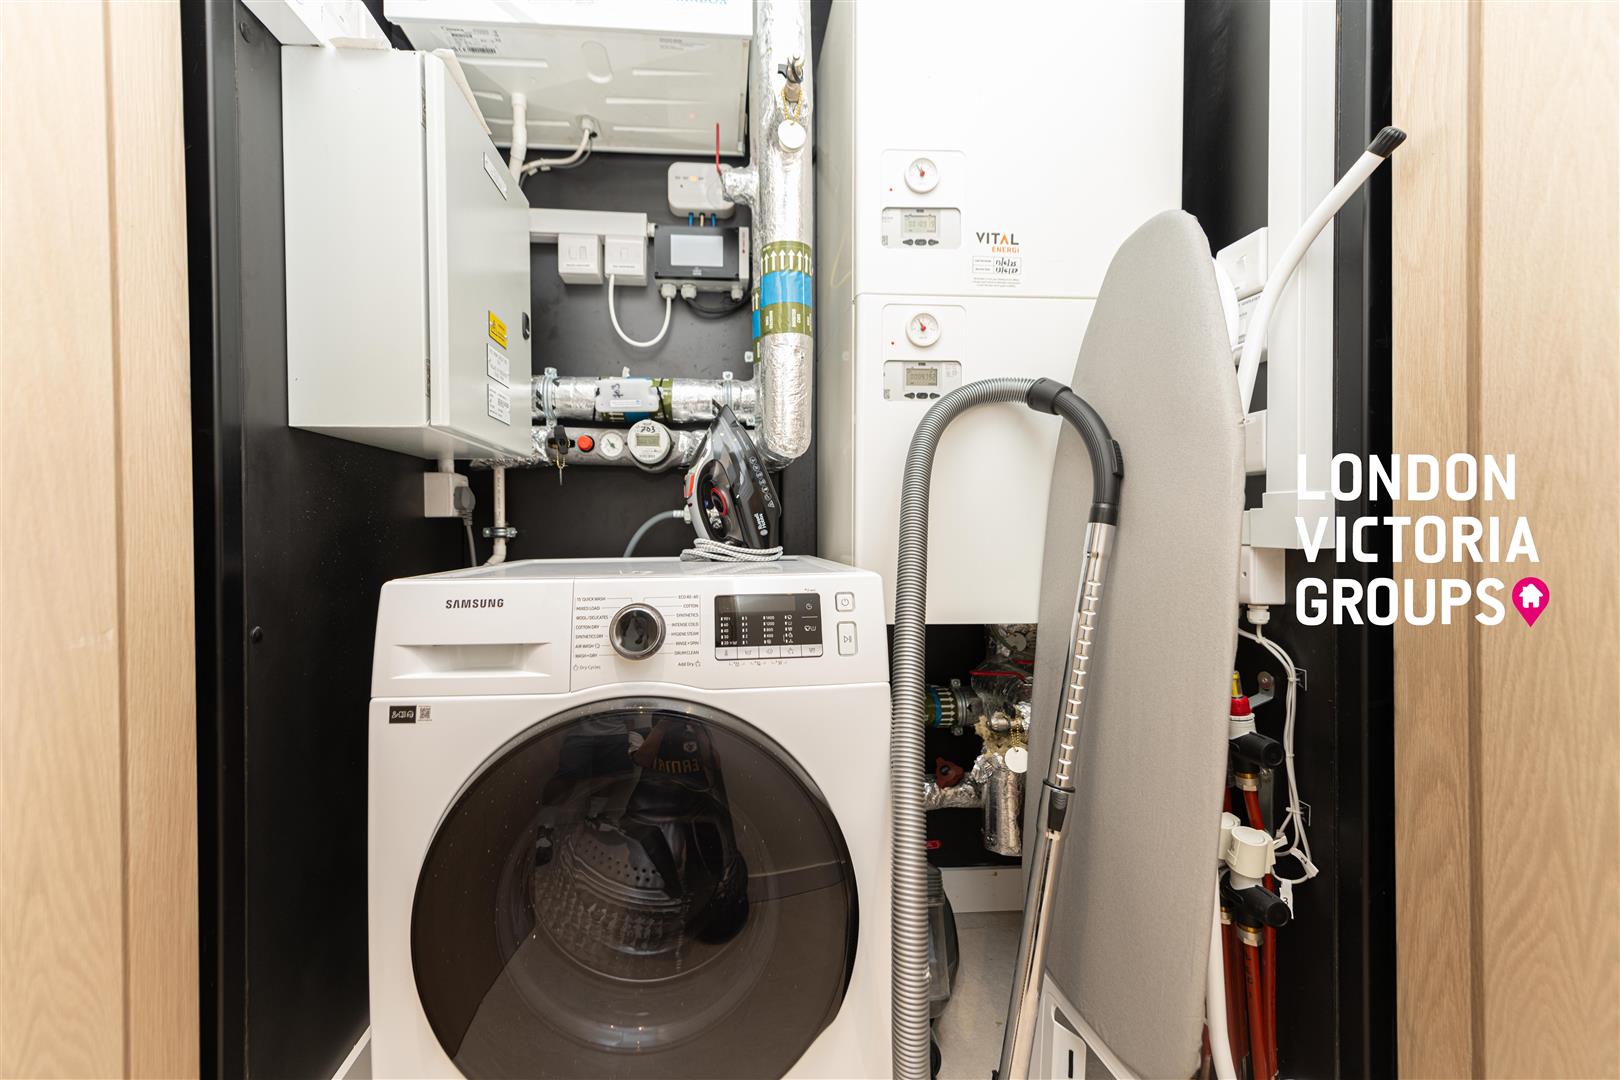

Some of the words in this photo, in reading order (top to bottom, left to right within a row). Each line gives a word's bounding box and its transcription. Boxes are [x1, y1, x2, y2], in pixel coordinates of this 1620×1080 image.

[976, 232, 1019, 245] VITAL
[446, 598, 504, 609] SAMSUNG
[1283, 897, 1289, 905] 3
